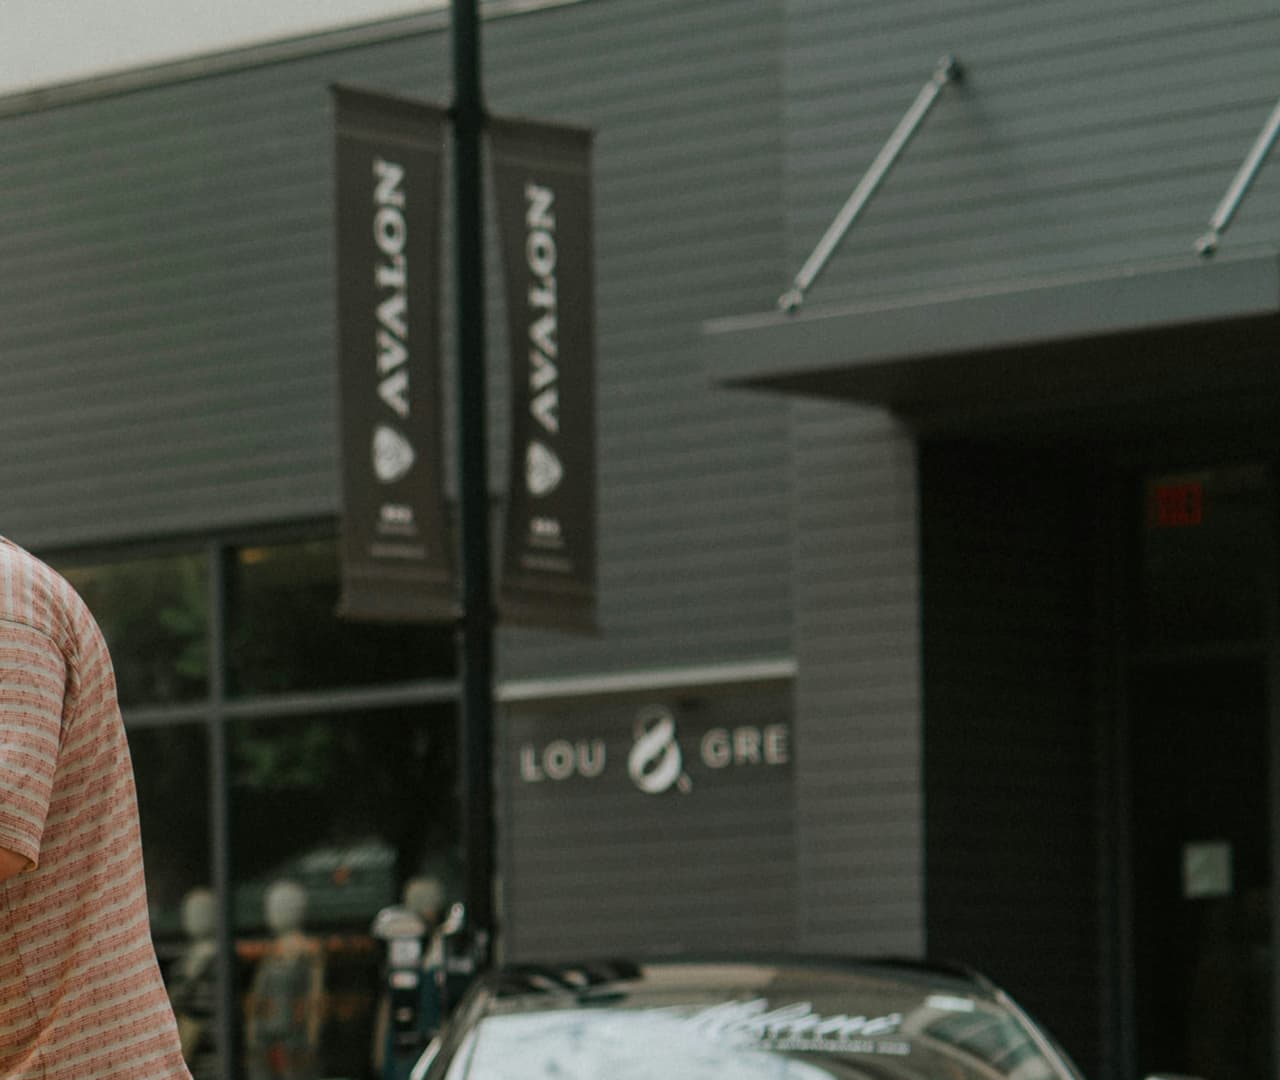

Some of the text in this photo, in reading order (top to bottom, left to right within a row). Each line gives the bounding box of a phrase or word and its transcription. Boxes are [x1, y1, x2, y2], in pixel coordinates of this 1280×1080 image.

[372, 156, 410, 419] AVALON
[524, 183, 560, 434] AVALON
[520, 738, 607, 783] LOU
